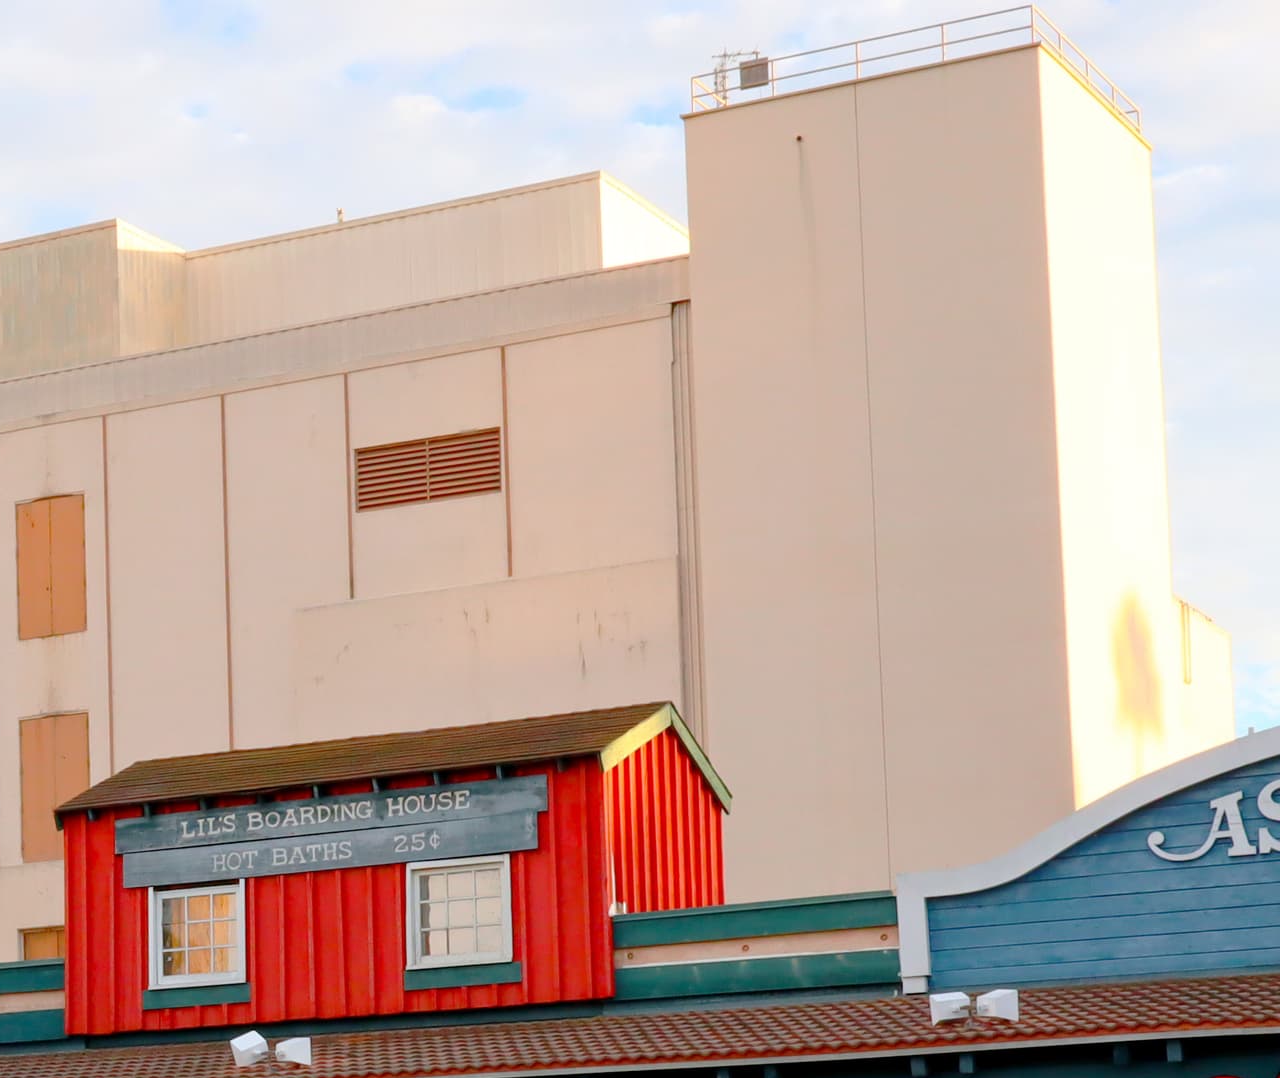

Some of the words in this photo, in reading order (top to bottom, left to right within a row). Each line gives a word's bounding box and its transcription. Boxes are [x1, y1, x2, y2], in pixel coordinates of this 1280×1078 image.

[180, 815, 237, 840] LIL'S
[246, 800, 373, 832] BOARDING
[386, 789, 472, 818] HOUSE
[211, 849, 258, 874] HOT
[271, 840, 353, 867] BATHS
[393, 829, 442, 855] 25¢
